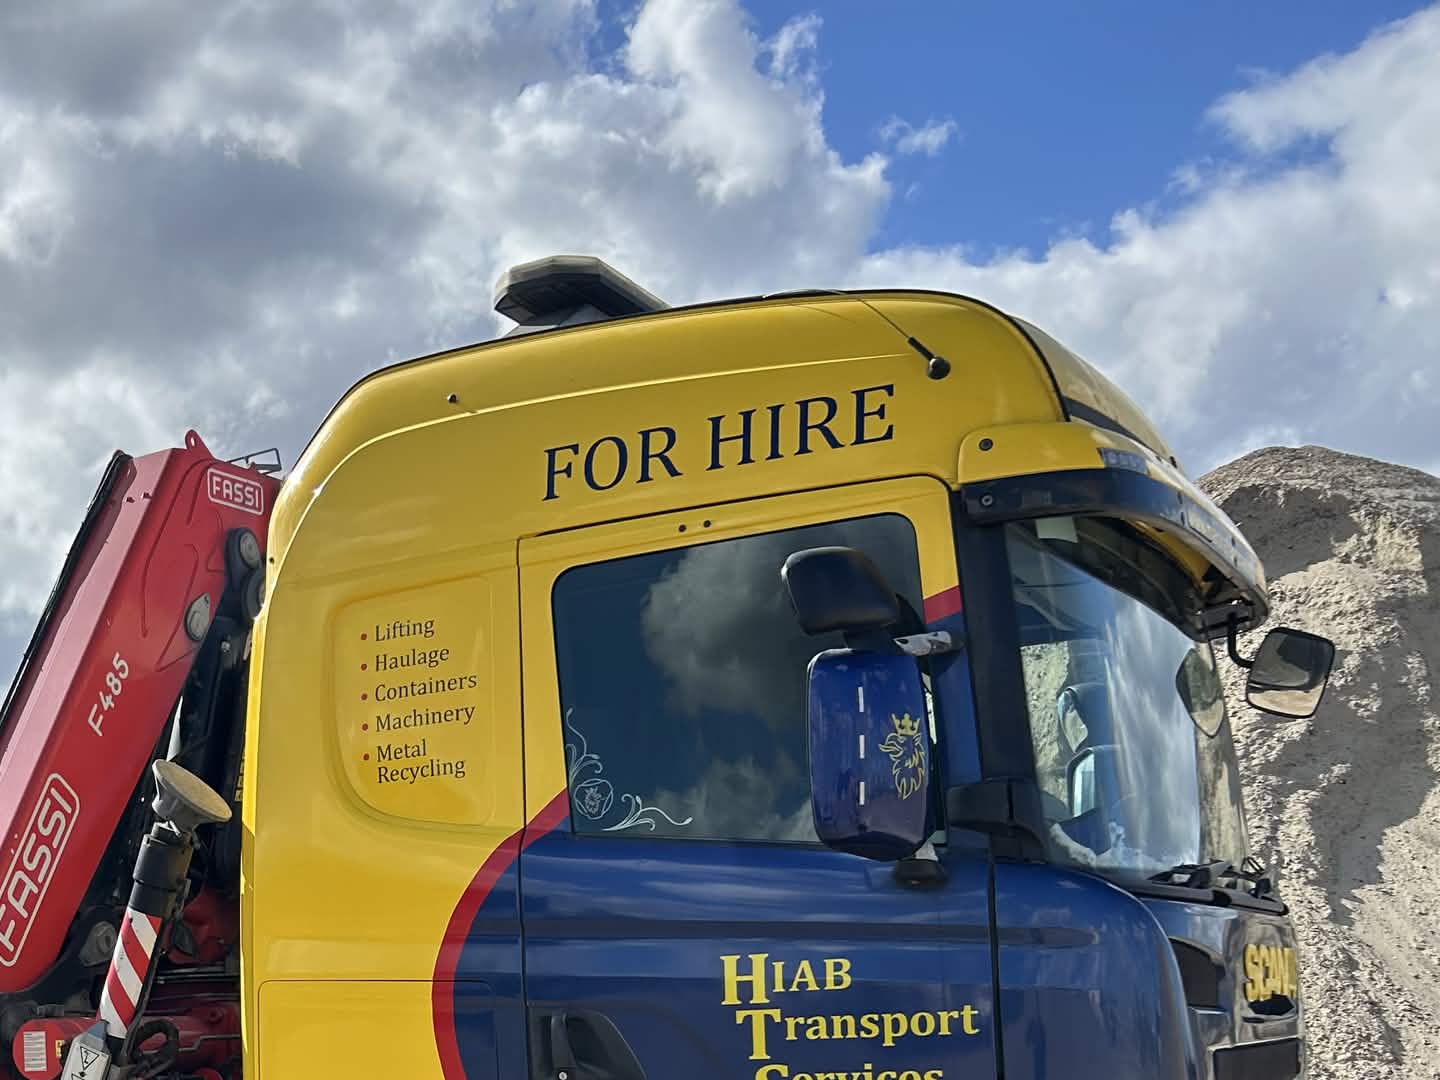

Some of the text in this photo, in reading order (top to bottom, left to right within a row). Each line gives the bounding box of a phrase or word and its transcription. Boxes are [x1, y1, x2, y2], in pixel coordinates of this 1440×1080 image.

[541, 383, 895, 501] FOR HIRE
[212, 475, 259, 509] FASSI
[374, 619, 435, 642] Lifting
[375, 648, 450, 672] Haulage
[87, 651, 129, 737] F485
[374, 674, 478, 702] Containers
[375, 705, 476, 732] Machinery
[376, 738, 427, 763] Metal
[377, 759, 466, 785] Recycling
[719, 953, 853, 1006] HIAB
[735, 1004, 980, 1060] Transport
